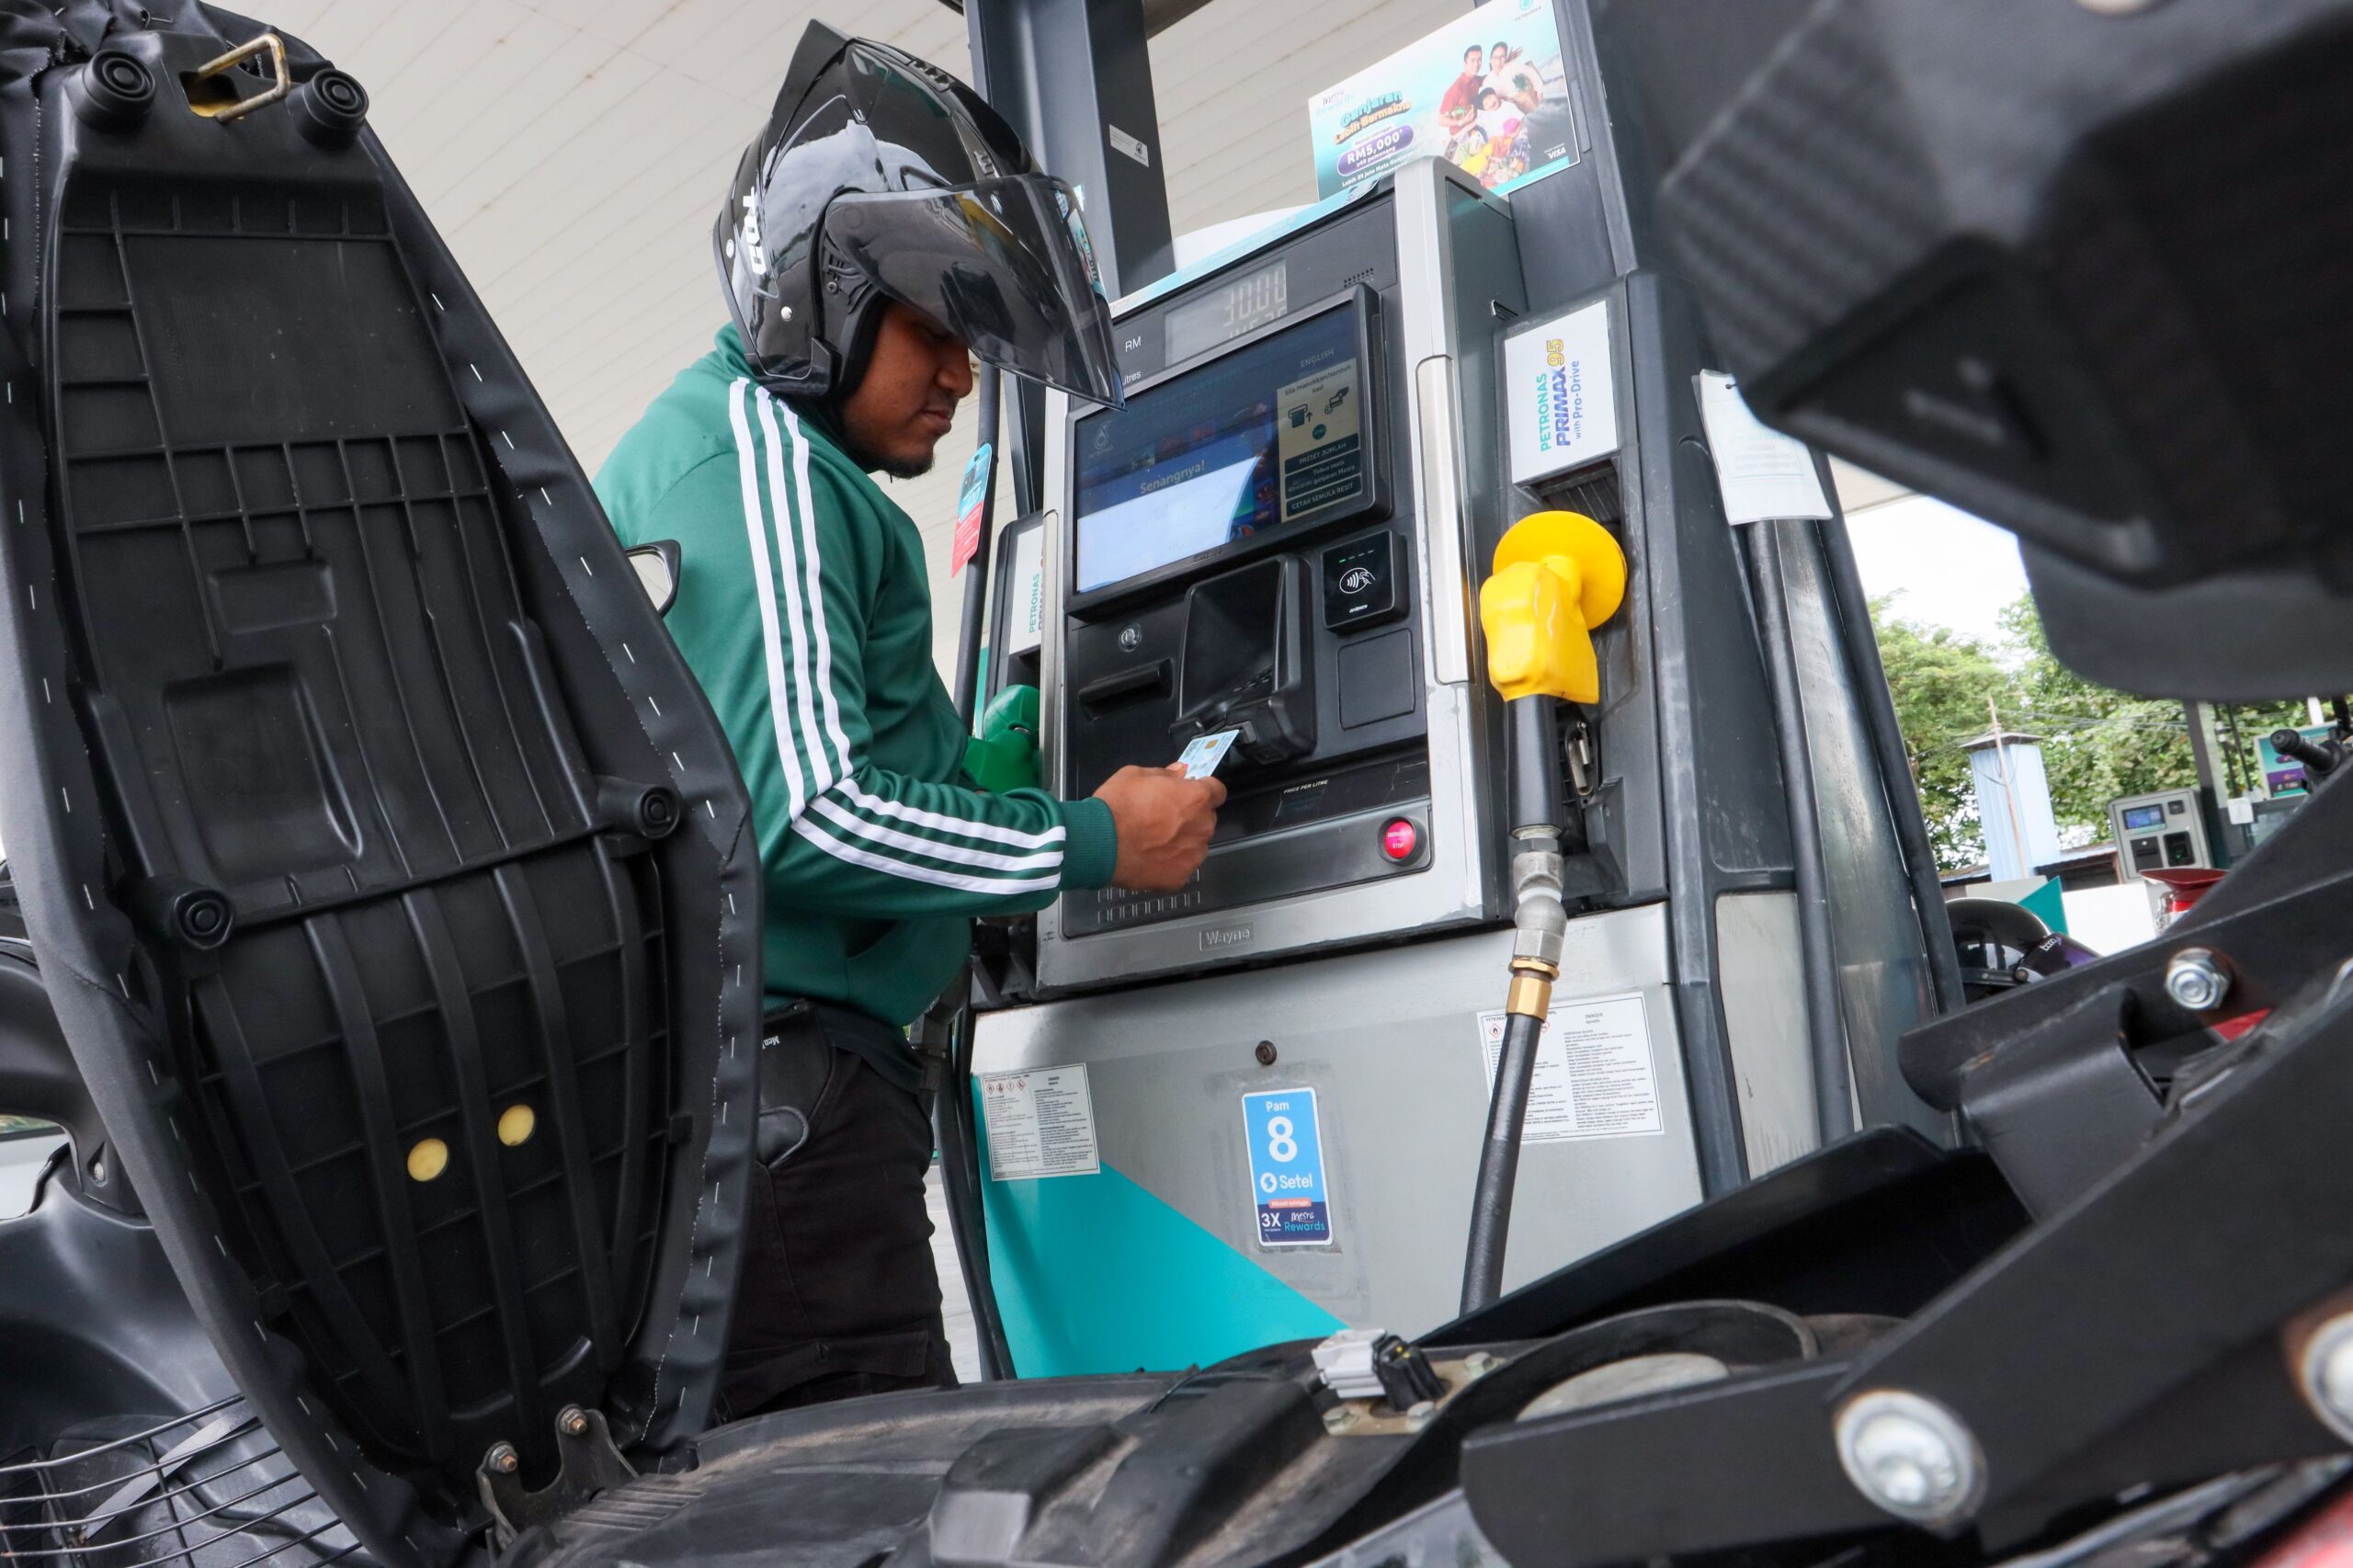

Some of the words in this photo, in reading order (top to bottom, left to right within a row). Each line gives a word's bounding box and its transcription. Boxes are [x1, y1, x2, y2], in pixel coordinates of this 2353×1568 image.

[1340, 90, 1403, 129] Ganjaran
[1548, 147, 1566, 159] VISA
[1124, 335, 1142, 353] RM
[1300, 347, 1335, 369] ENGLISH
[1284, 387, 1296, 397] Sila
[1312, 383, 1324, 393] kad
[1570, 359, 1585, 420] Pro-Drive
[1537, 372, 1551, 452] PETRONAS
[1574, 420, 1583, 440] with
[1140, 458, 1206, 494] Senangnya!
[1291, 497, 1312, 510] CETAK
[1312, 489, 1336, 504] SEMULA
[1336, 482, 1354, 494] RESIT
[1029, 573, 1040, 633] PETRONAS
[1283, 786, 1300, 795] PRICE
[1300, 782, 1313, 791] PER
[1312, 778, 1330, 788] LITRE
[1206, 927, 1250, 945] Wayne
[1266, 1100, 1290, 1112] Pam
[1267, 1116, 1298, 1163] 8
[1279, 1173, 1313, 1189] Setel
[1260, 1212, 1281, 1228] 3X
[1284, 1221, 1325, 1233] Rewards
